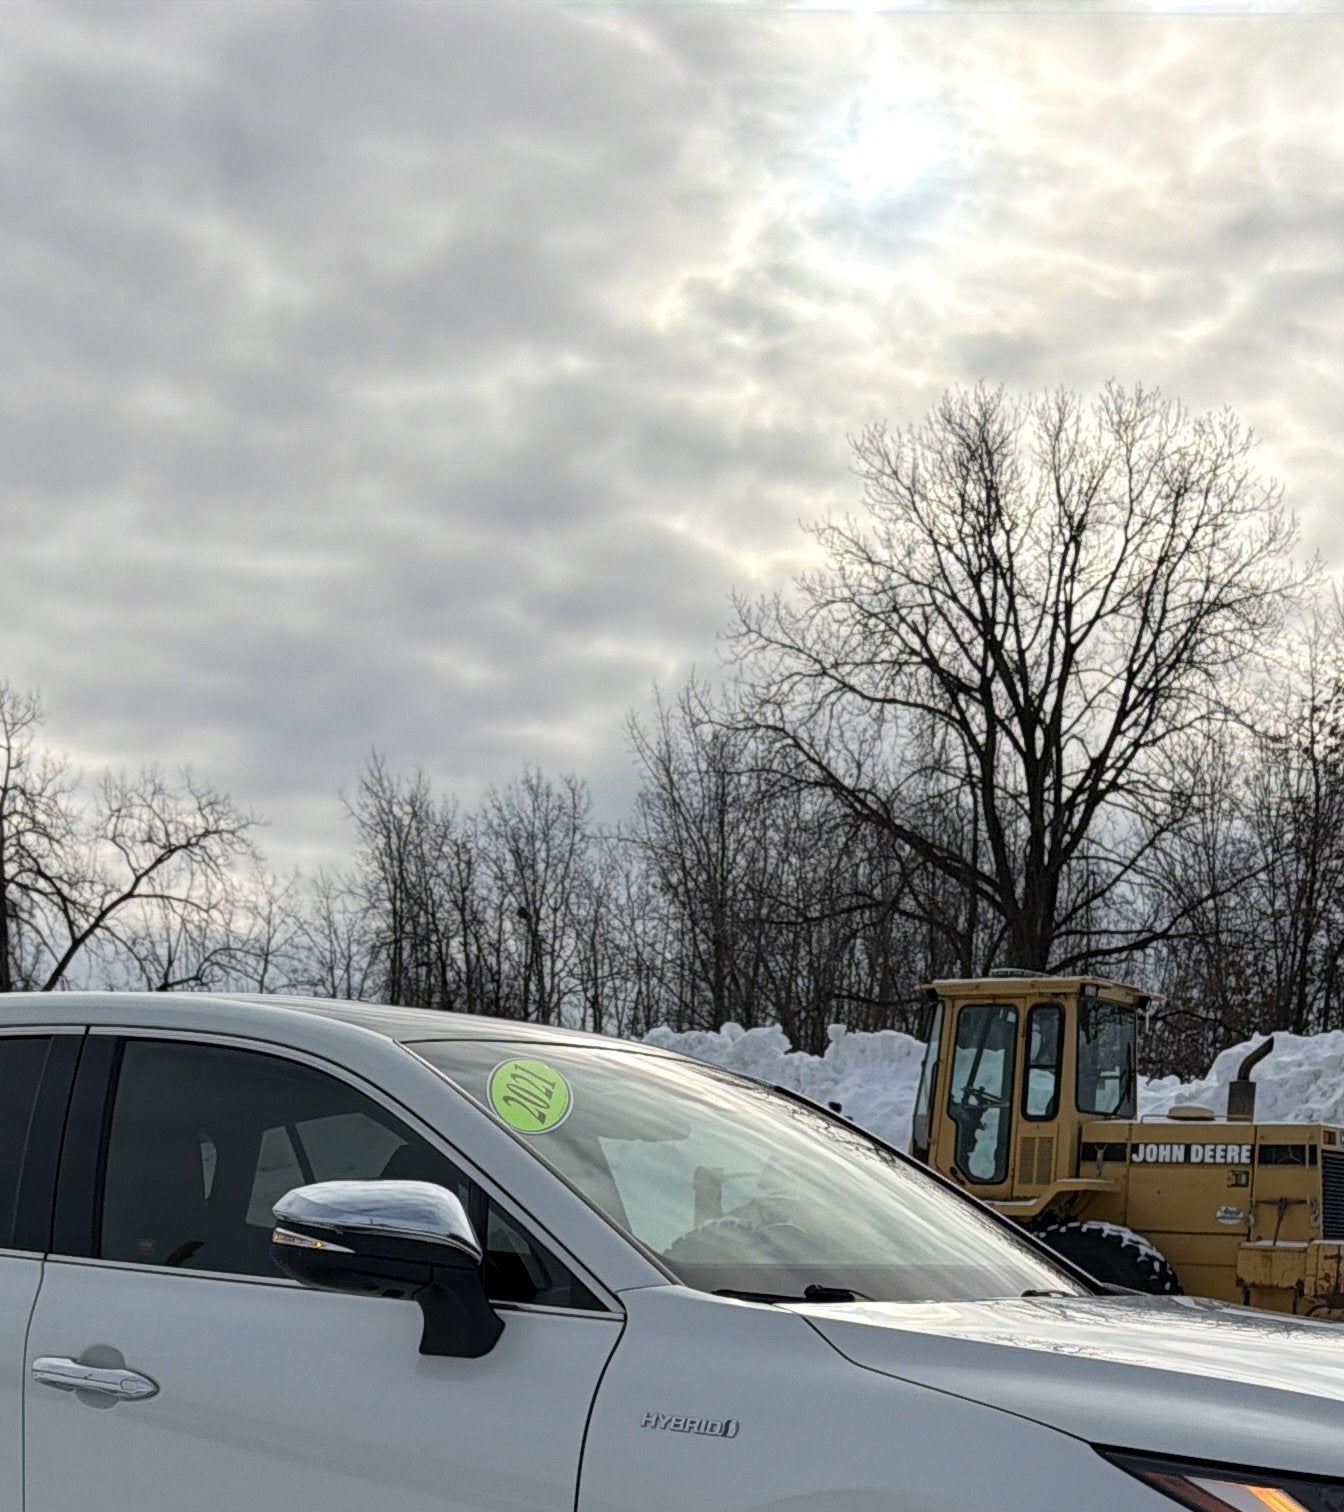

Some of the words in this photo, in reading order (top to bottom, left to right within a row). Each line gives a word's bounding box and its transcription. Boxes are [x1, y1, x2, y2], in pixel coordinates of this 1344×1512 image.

[503, 1064, 556, 1125] 2021
[1131, 1143, 1186, 1163] JOHN
[1190, 1144, 1252, 1164] DEERE
[640, 1412, 725, 1437] HYBRID
